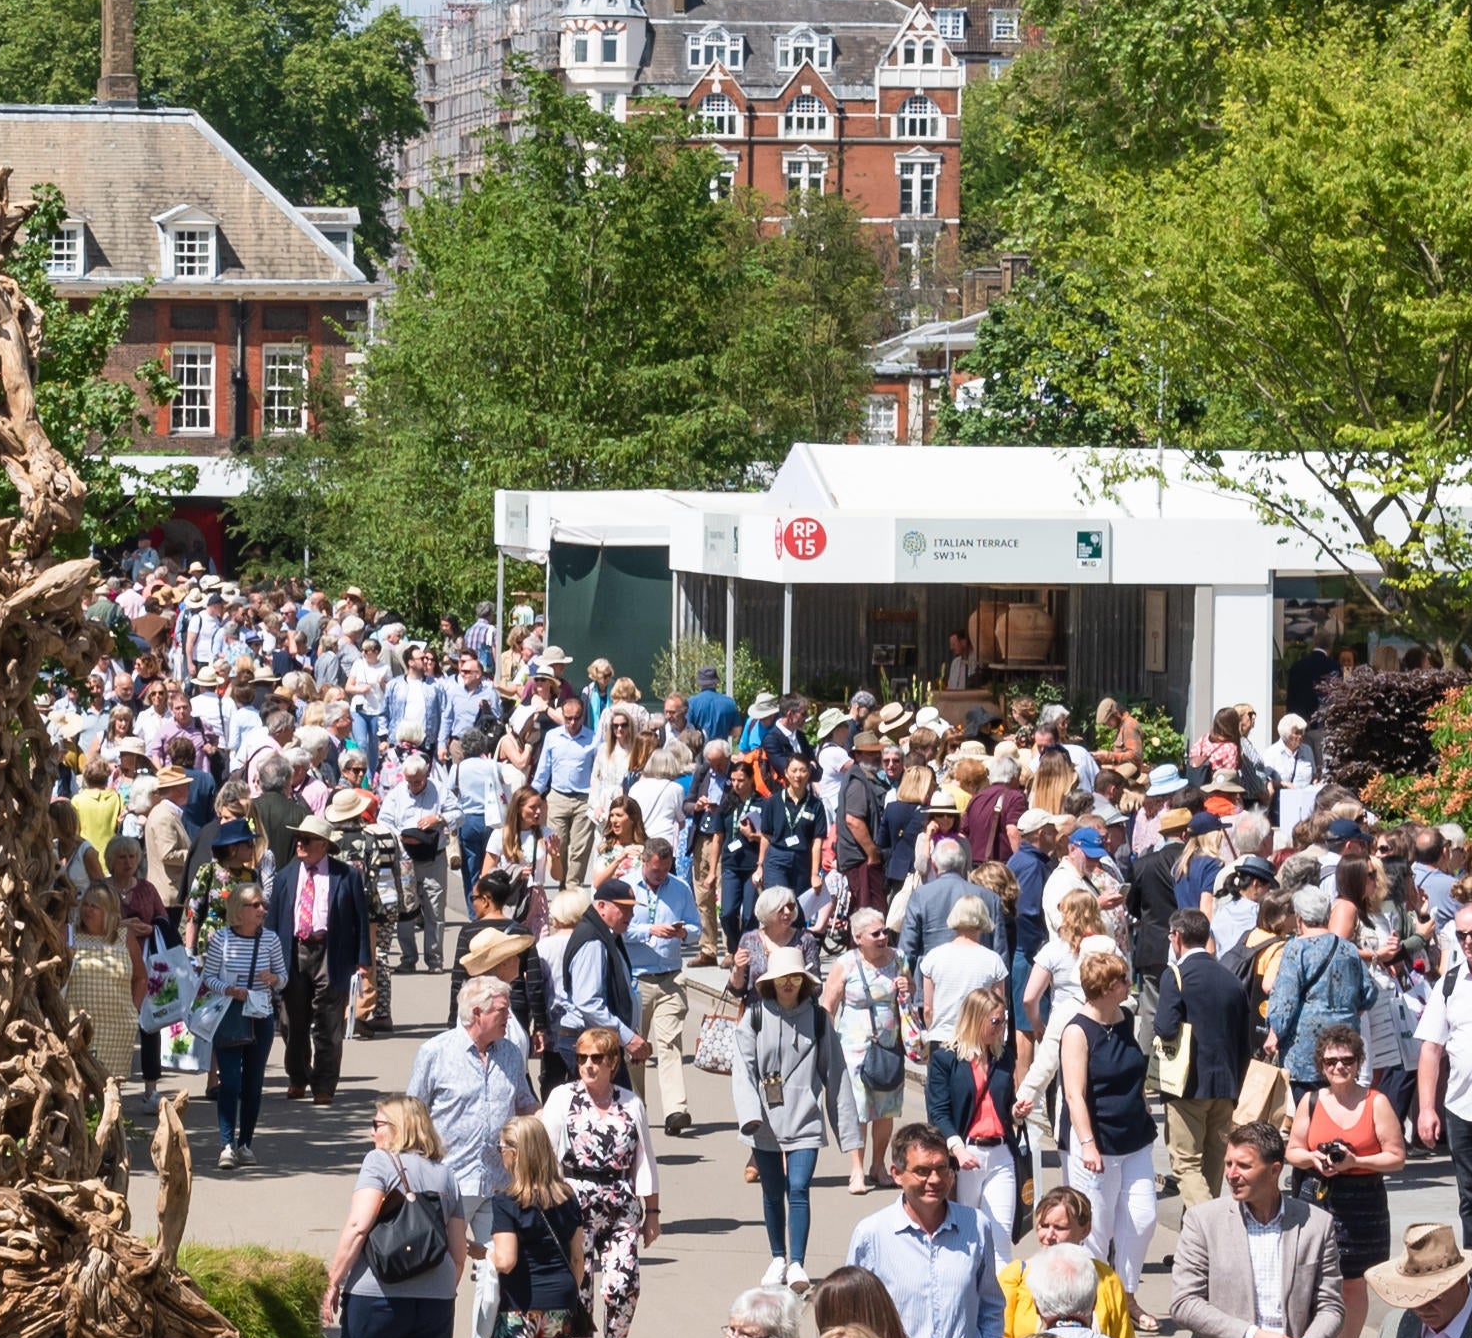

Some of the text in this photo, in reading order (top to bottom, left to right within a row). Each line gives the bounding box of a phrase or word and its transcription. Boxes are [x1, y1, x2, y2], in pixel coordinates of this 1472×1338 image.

[793, 521, 818, 538] RP
[795, 539, 816, 556] 15
[933, 538, 1020, 549] ITALIAN TERRACE
[933, 551, 968, 561] SW314
